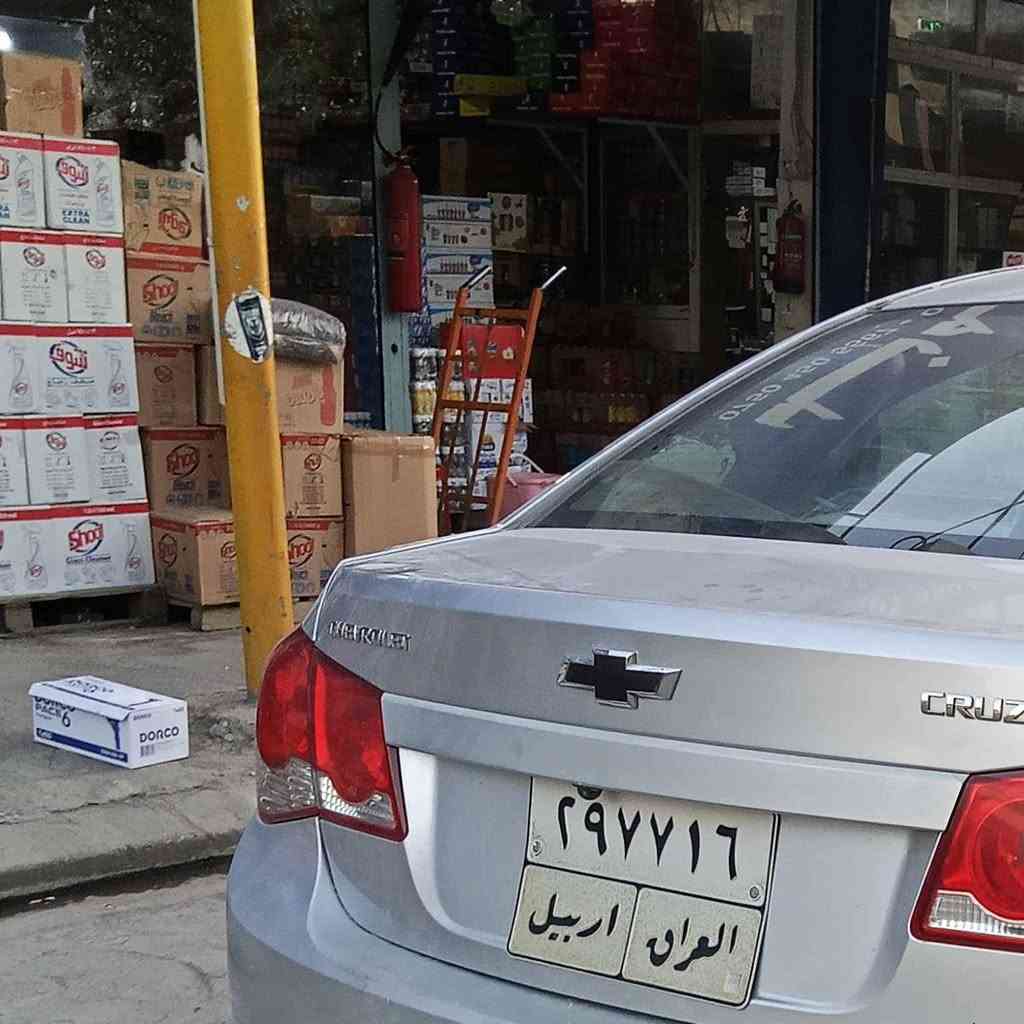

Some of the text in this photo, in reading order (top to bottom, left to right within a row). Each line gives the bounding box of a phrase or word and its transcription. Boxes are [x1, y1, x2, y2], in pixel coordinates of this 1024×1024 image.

[139, 726, 179, 743] DORCO
[557, 796, 739, 880] ٢٩٧٧١٦
[528, 892, 620, 943] اربيل
[645, 917, 739, 972] العراق
